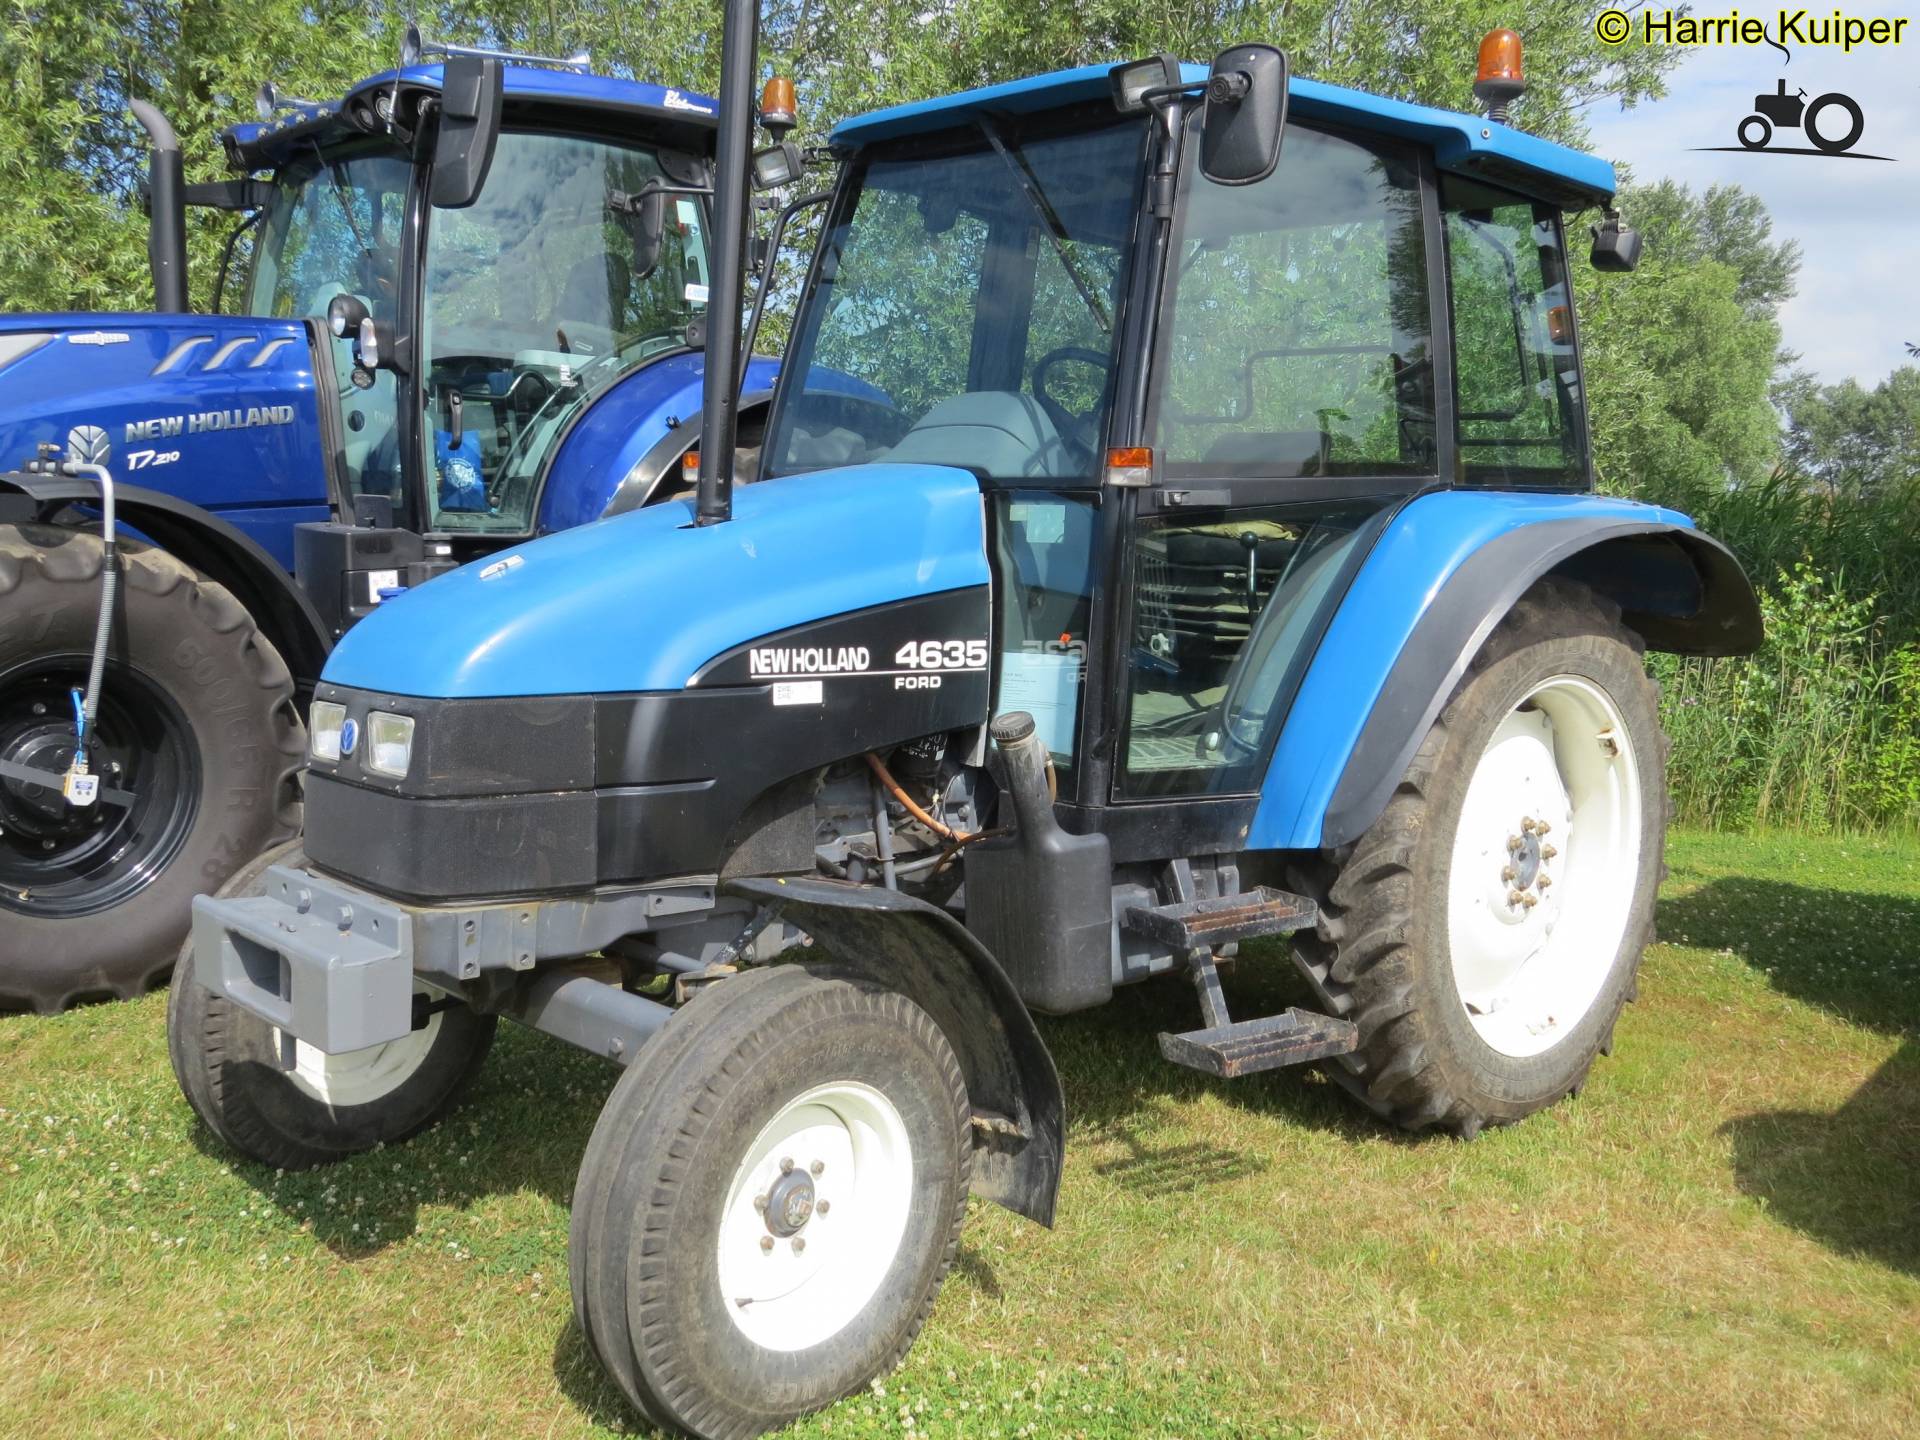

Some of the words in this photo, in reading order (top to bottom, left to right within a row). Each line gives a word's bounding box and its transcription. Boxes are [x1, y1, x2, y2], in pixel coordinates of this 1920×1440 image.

[125, 415, 184, 443] NEW
[188, 405, 295, 434] HOLLAND
[750, 648, 790, 674] NEW
[792, 646, 870, 673] HOLLAND
[895, 640, 988, 669] 4635
[894, 675, 942, 690] FORD
